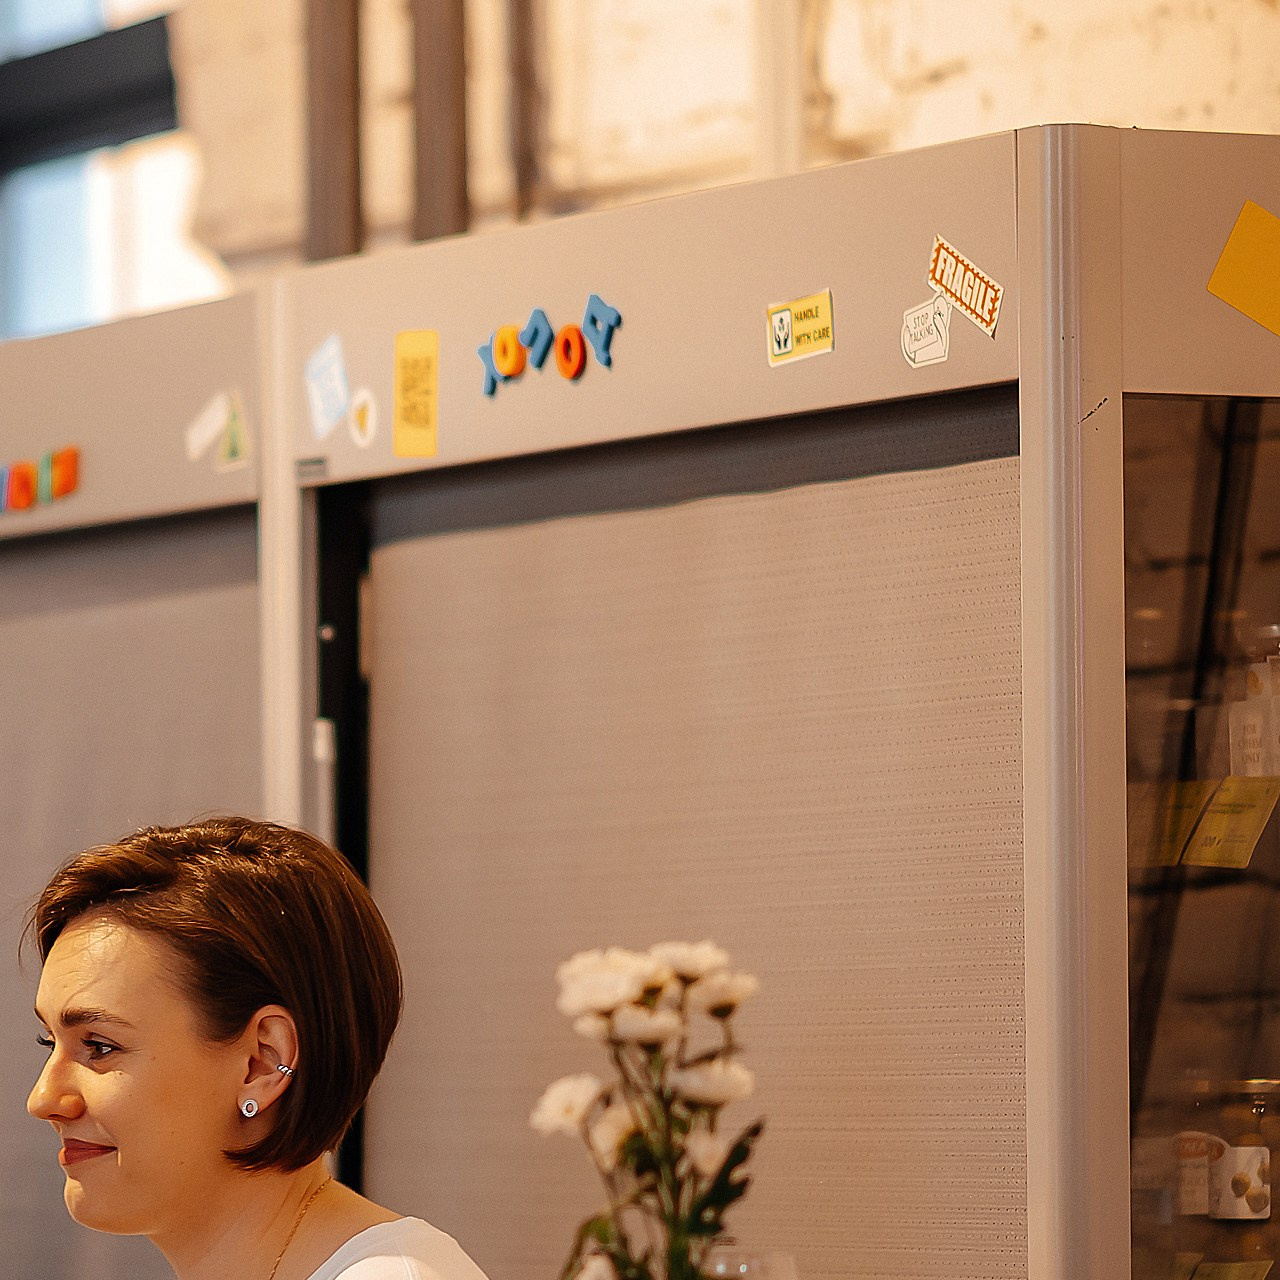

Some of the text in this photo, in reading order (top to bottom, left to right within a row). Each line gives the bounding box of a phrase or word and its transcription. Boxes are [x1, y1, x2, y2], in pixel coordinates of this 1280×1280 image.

[934, 247, 996, 322] FRAGILE
[794, 306, 819, 323] HANDLE
[913, 312, 929, 330] STOP
[795, 326, 830, 347] WITH CARE
[910, 323, 934, 344] TALKING
